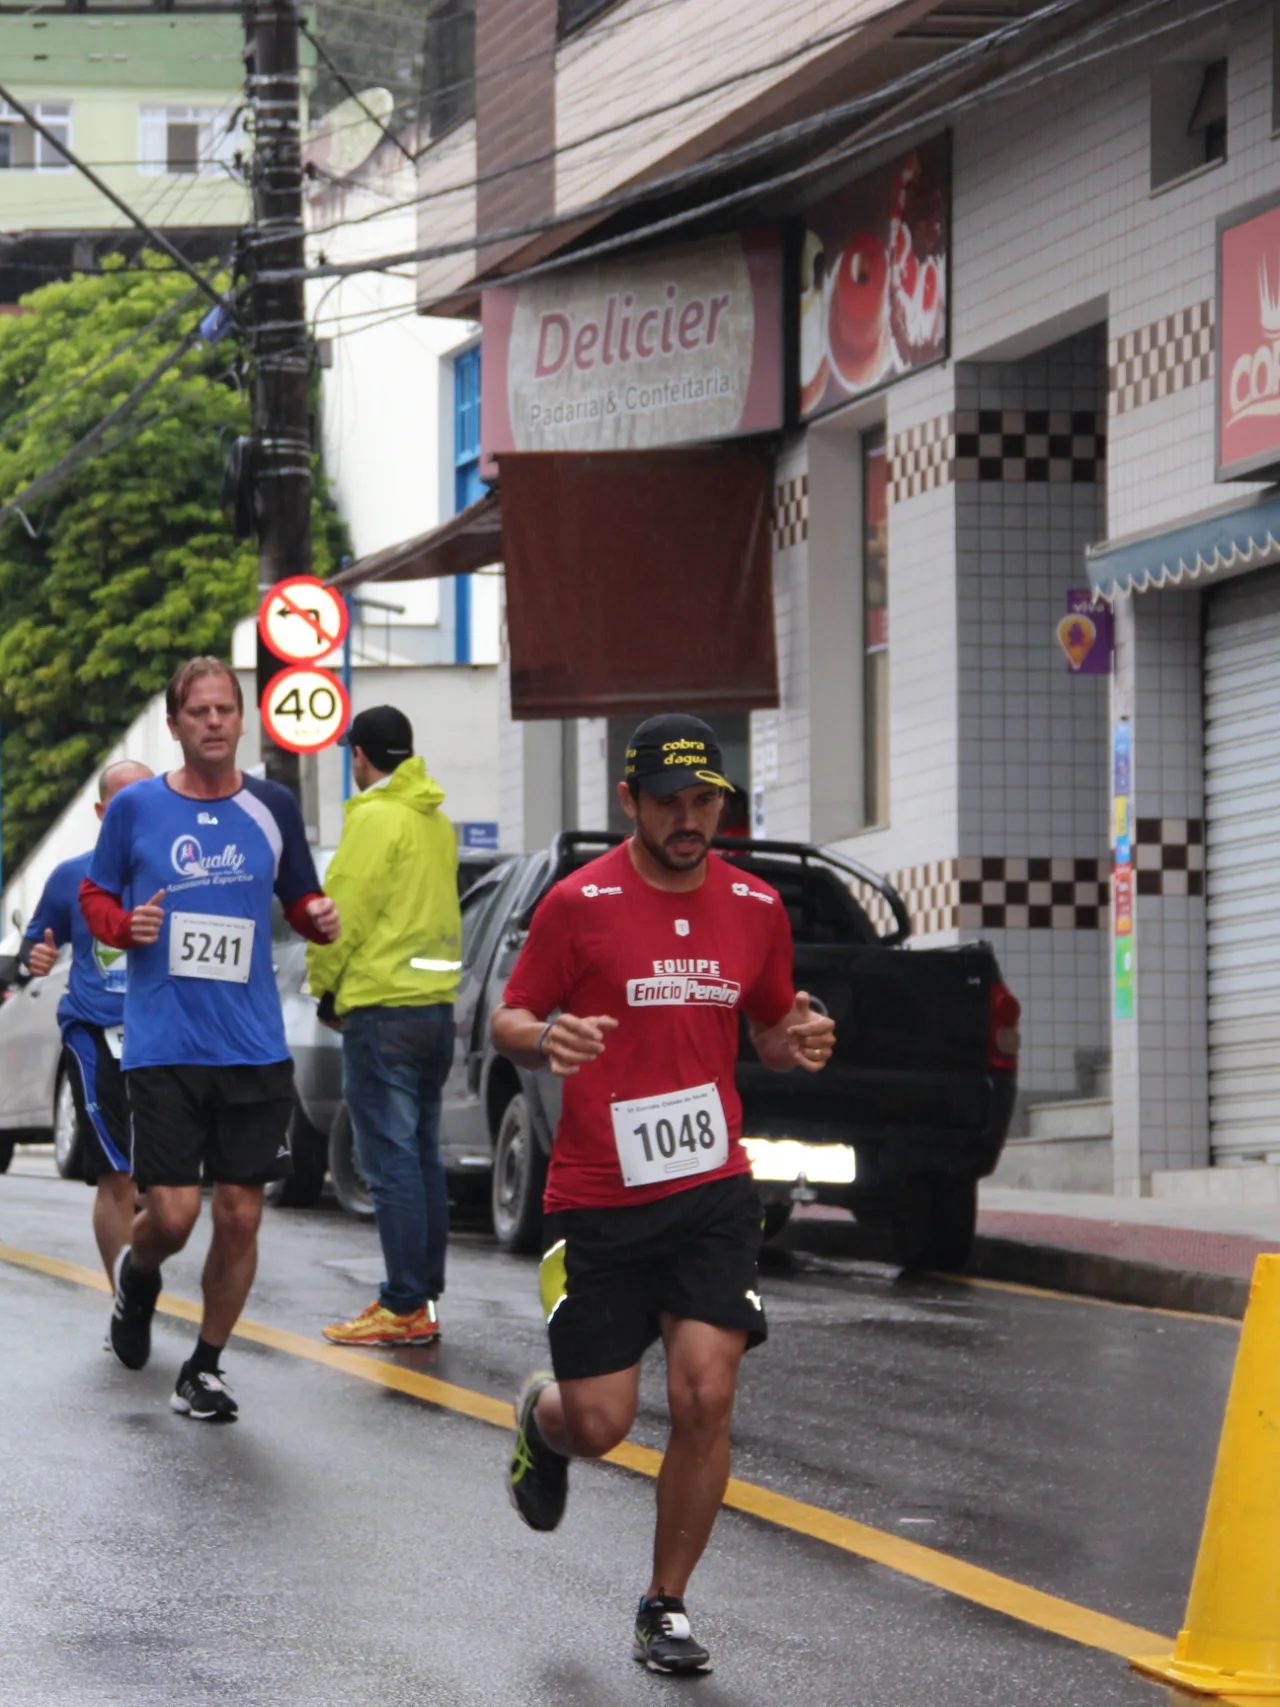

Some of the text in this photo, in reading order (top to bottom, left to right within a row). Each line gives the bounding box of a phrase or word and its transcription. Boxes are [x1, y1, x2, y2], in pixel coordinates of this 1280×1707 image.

[534, 284, 730, 379] Delicier
[530, 371, 731, 428] Padaria & Confeitaria
[273, 687, 337, 722] 40
[661, 738, 706, 752] cobra
[180, 932, 242, 967] 5241
[652, 958, 720, 975] EQUIPE
[633, 979, 740, 1004] Enício Pereira
[633, 1109, 716, 1162] 1048
